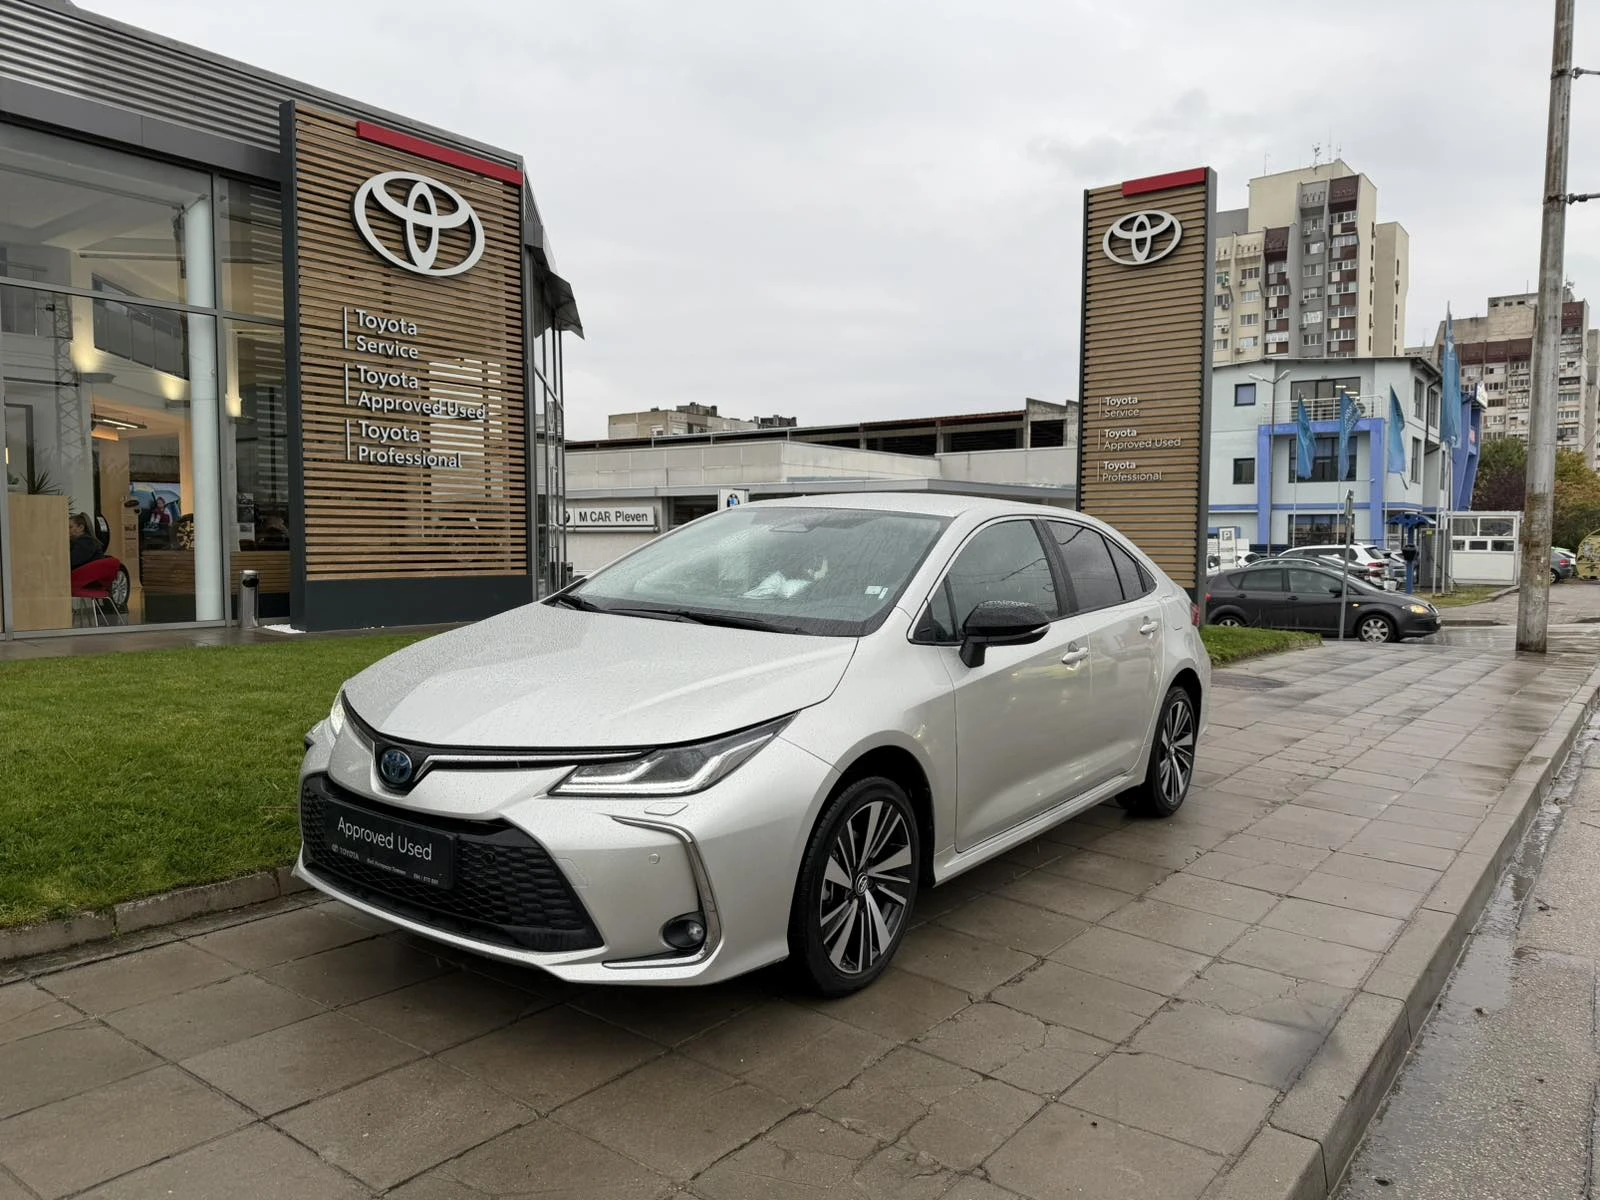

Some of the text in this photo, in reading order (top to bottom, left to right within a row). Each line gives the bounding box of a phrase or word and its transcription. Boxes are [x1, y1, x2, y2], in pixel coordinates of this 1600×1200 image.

[355, 308, 418, 336] Toyota
[356, 335, 419, 359] Service
[357, 364, 419, 389] Toyota
[358, 391, 486, 419] Approved Used
[1105, 396, 1138, 407] Toyota
[1104, 408, 1140, 418] Service
[358, 419, 420, 444] Toyota
[1104, 428, 1137, 439] Toyota
[1104, 436, 1181, 451] Approved Used
[358, 446, 463, 469] Professional
[1103, 461, 1136, 471] Toyota
[1102, 471, 1162, 482] Professional
[579, 510, 648, 522] M CAR Pleven
[337, 816, 432, 861] Approved Used
